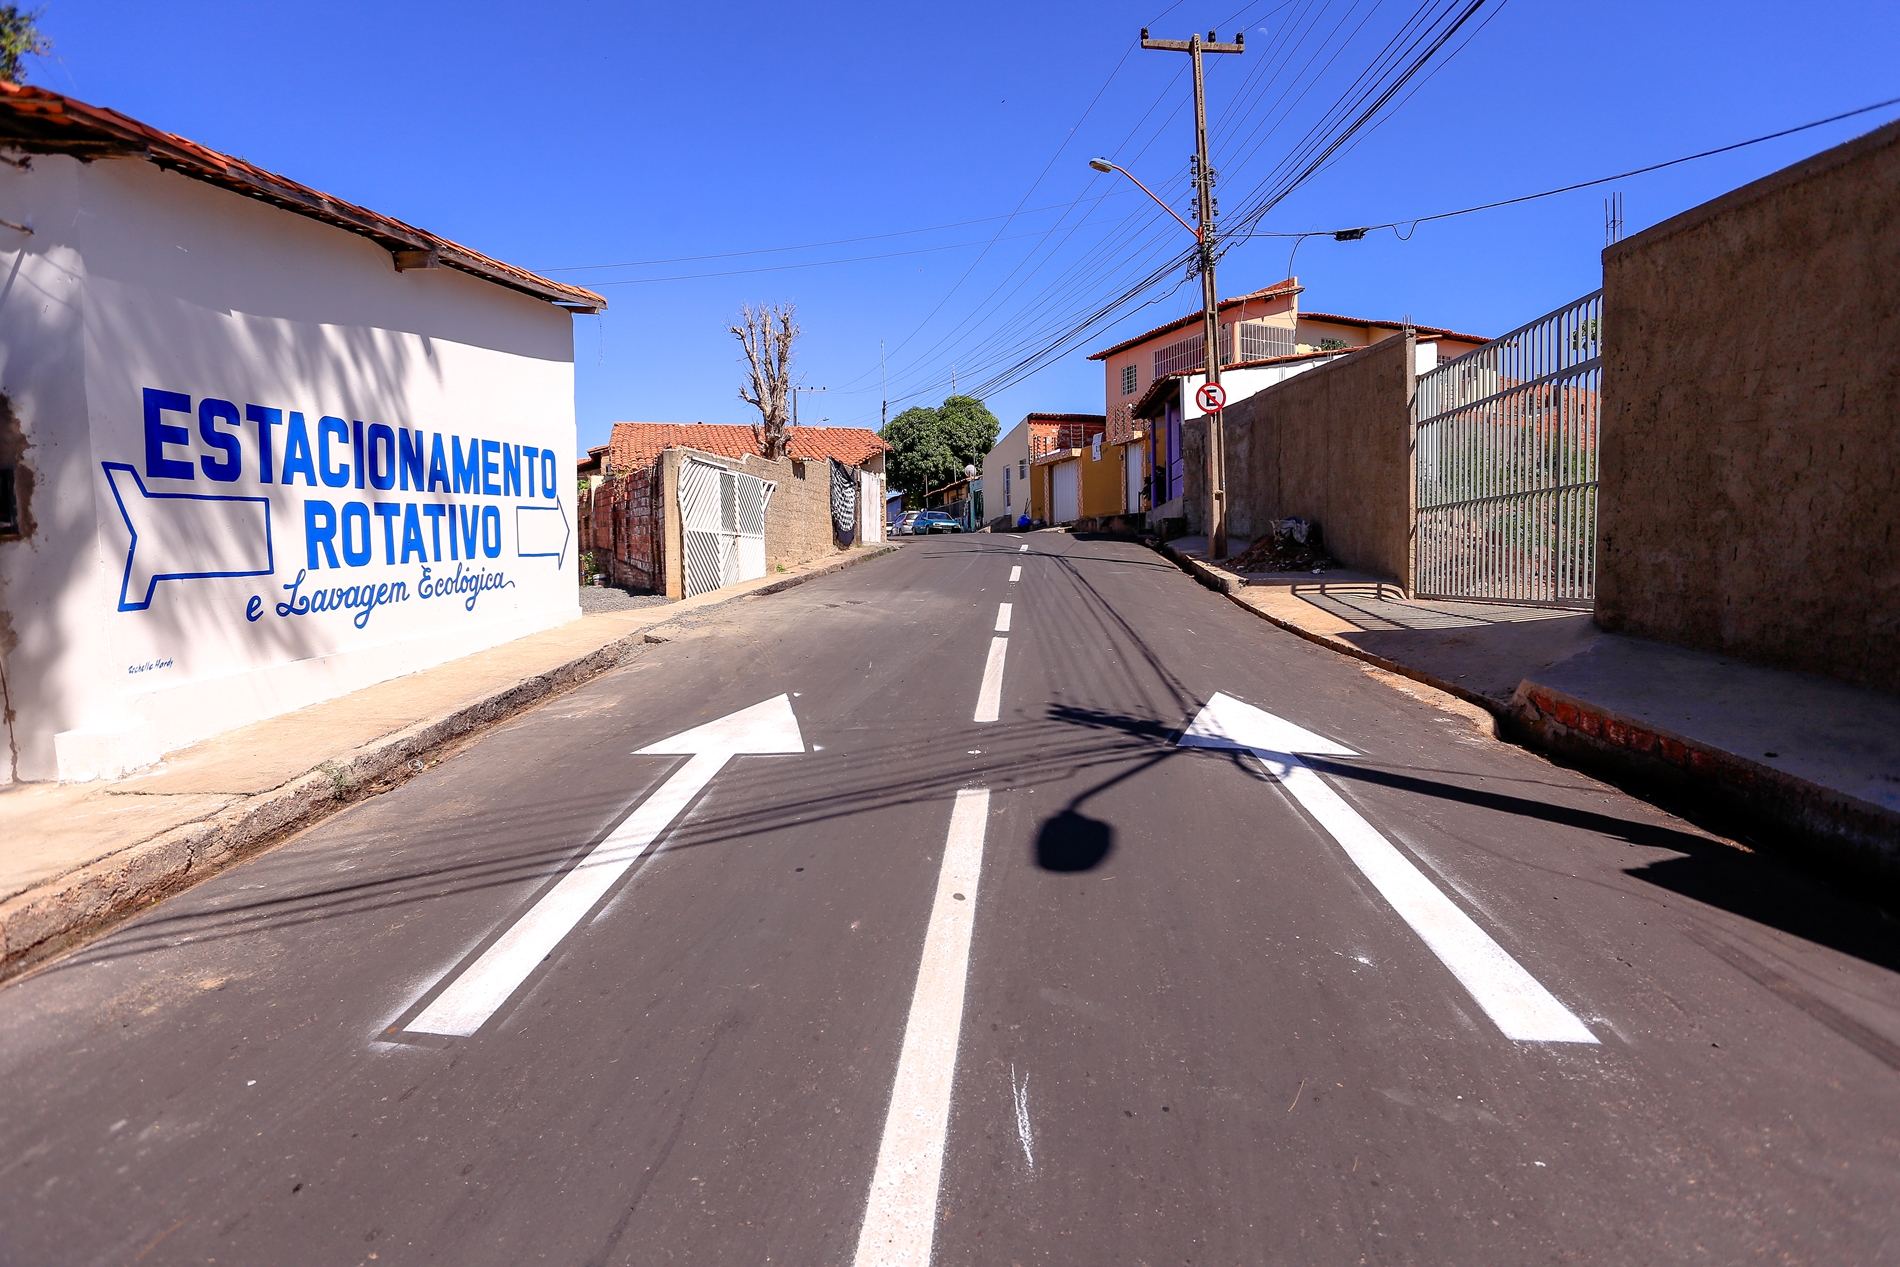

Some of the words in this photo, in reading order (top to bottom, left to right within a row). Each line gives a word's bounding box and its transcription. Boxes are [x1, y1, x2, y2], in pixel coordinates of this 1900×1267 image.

[1206, 389, 1217, 406] E
[142, 387, 557, 500] ESTACIONAMENTO
[303, 499, 502, 571] ROTATIVO
[246, 595, 264, 622] e
[276, 568, 410, 629] Lavagem
[418, 562, 516, 612] Ecológica
